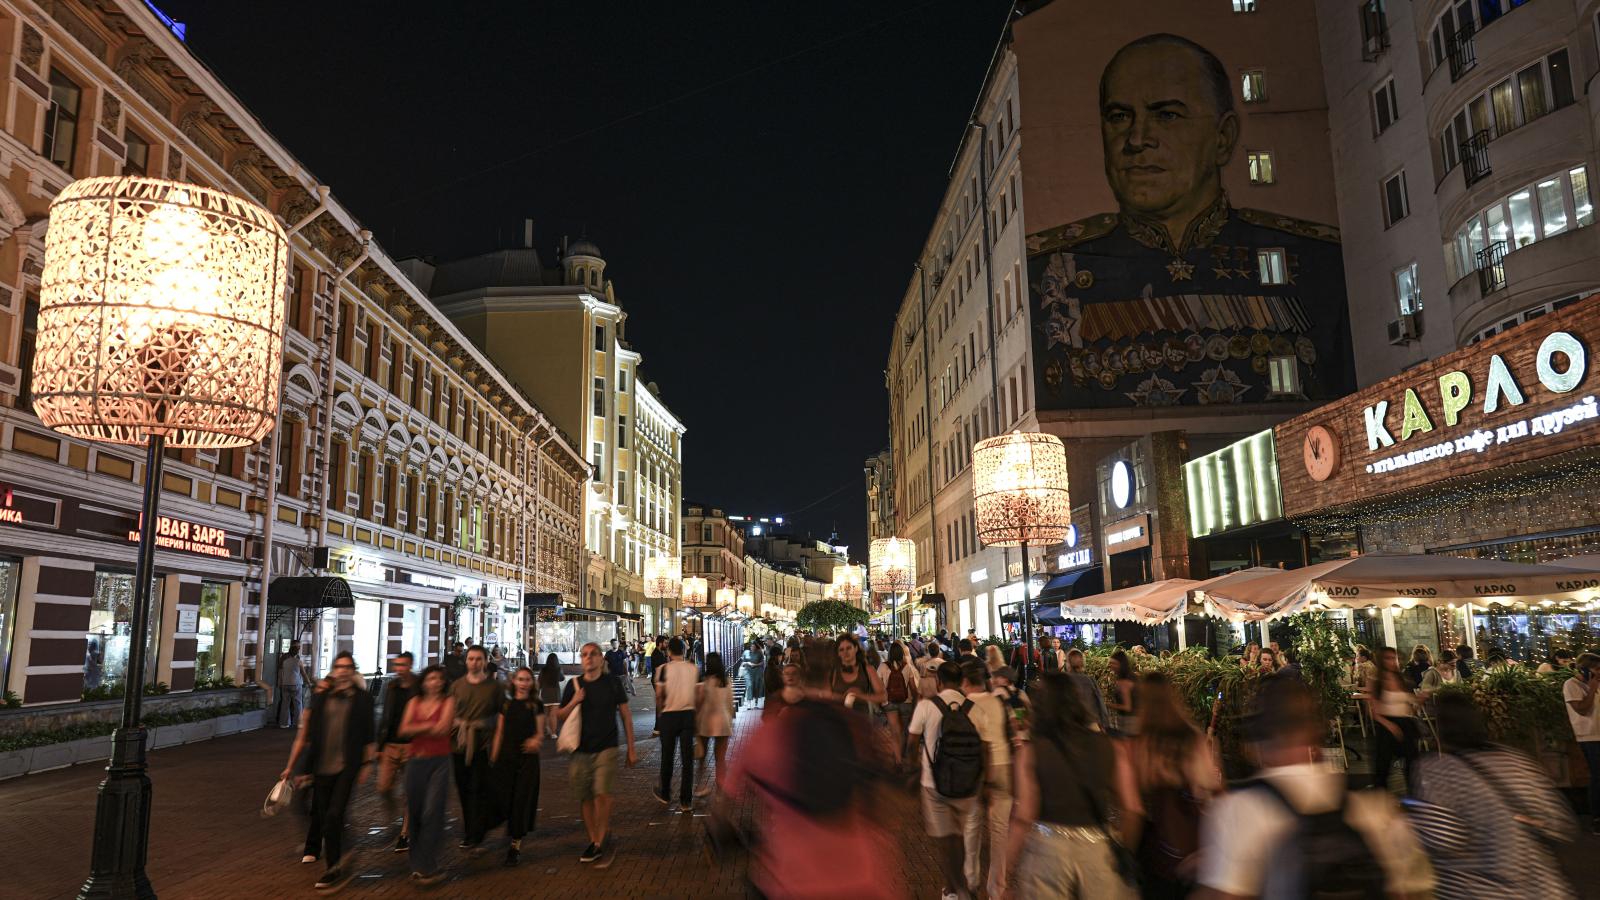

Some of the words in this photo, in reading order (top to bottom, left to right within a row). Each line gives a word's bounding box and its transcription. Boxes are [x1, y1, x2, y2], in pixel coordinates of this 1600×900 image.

[1364, 331, 1587, 451] КАРЛО
[1374, 441, 1454, 474] итальянское
[1455, 428, 1495, 453] кафе
[1496, 420, 1529, 445] для
[1531, 395, 1600, 436] друзей
[139, 512, 190, 539] ВАЯ
[192, 524, 225, 547] ЗАРЯ
[185, 541, 191, 551] И
[191, 542, 230, 558] КОСМЕТИКА
[1396, 587, 1437, 597] КАРЛО
[1474, 583, 1516, 594] КАРЛО
[1556, 579, 1599, 591] КАРЛО
